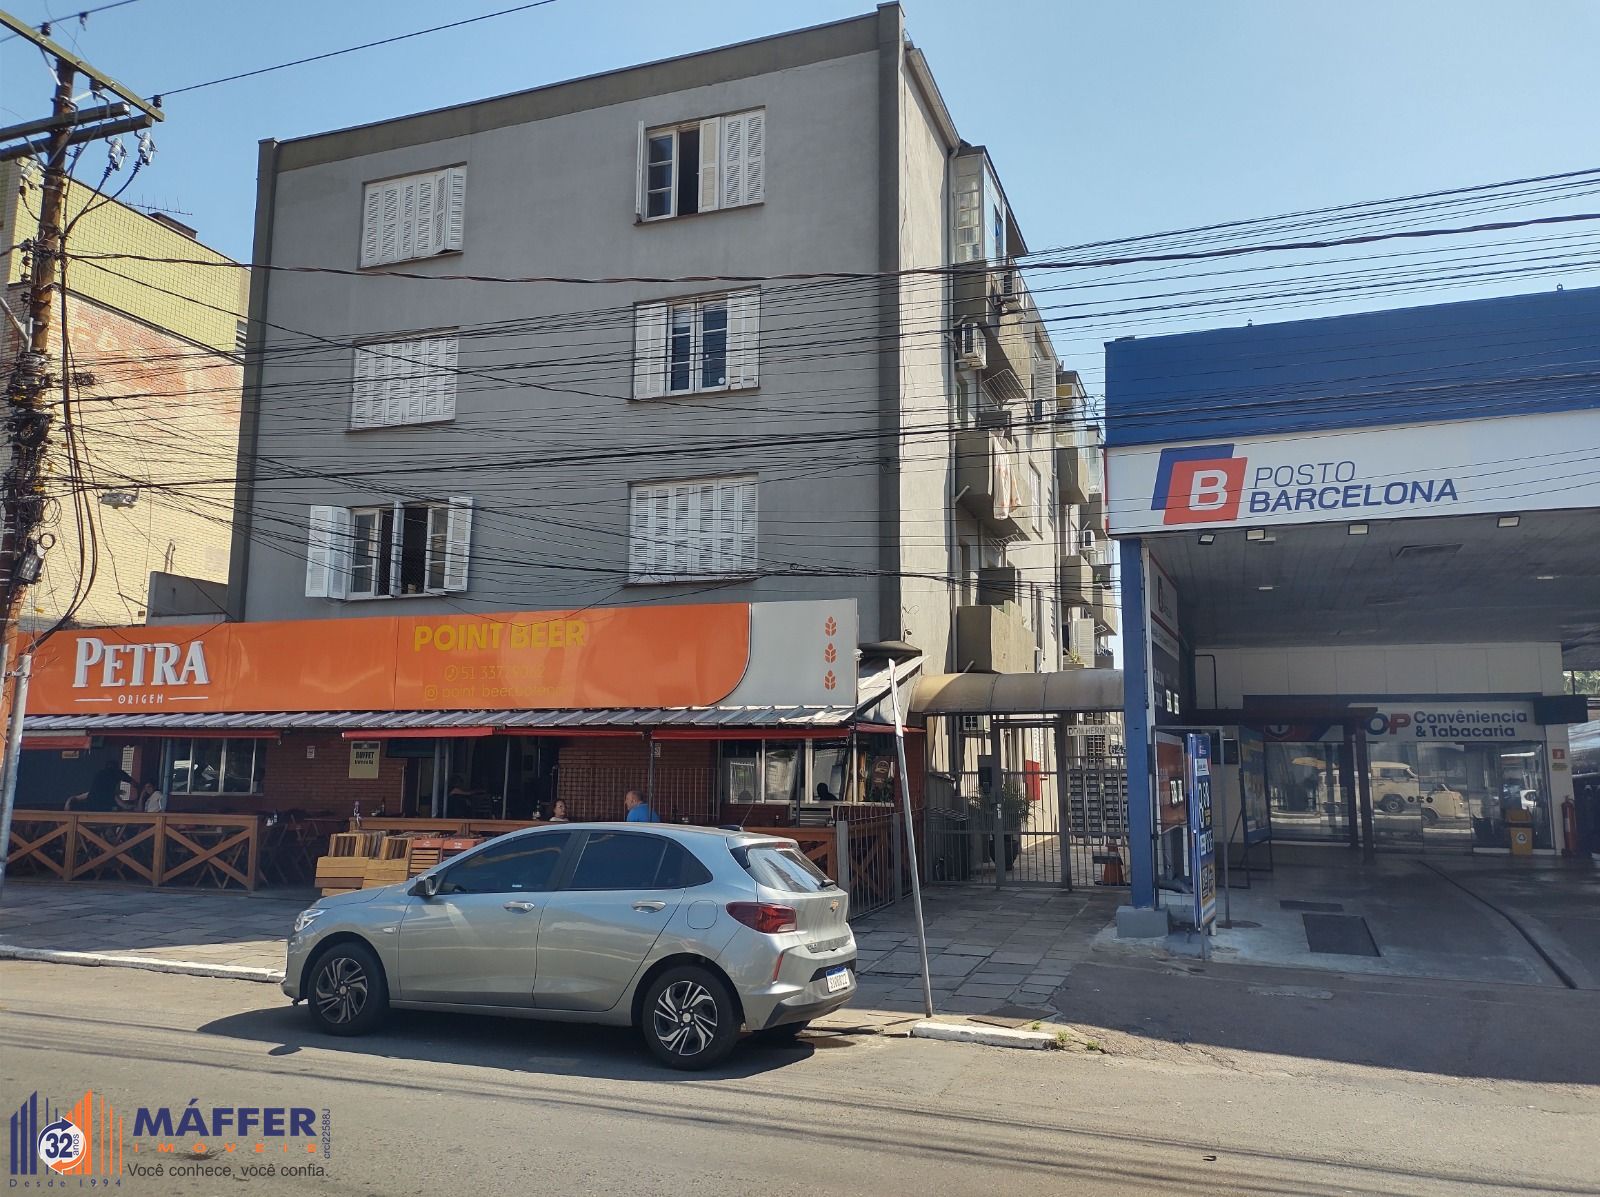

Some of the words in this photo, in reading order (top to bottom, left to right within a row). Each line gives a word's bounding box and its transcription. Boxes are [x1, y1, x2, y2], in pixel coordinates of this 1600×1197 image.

[1188, 469, 1229, 511] B
[1254, 461, 1356, 488] POSTO
[1249, 478, 1459, 513] BARCELONA
[414, 622, 503, 652] POINT
[510, 620, 587, 649] BEER
[72, 637, 210, 688] PETRA
[1413, 709, 1528, 724] Convêniencia
[1415, 725, 1427, 737] &
[1429, 723, 1516, 738] Tabacaria
